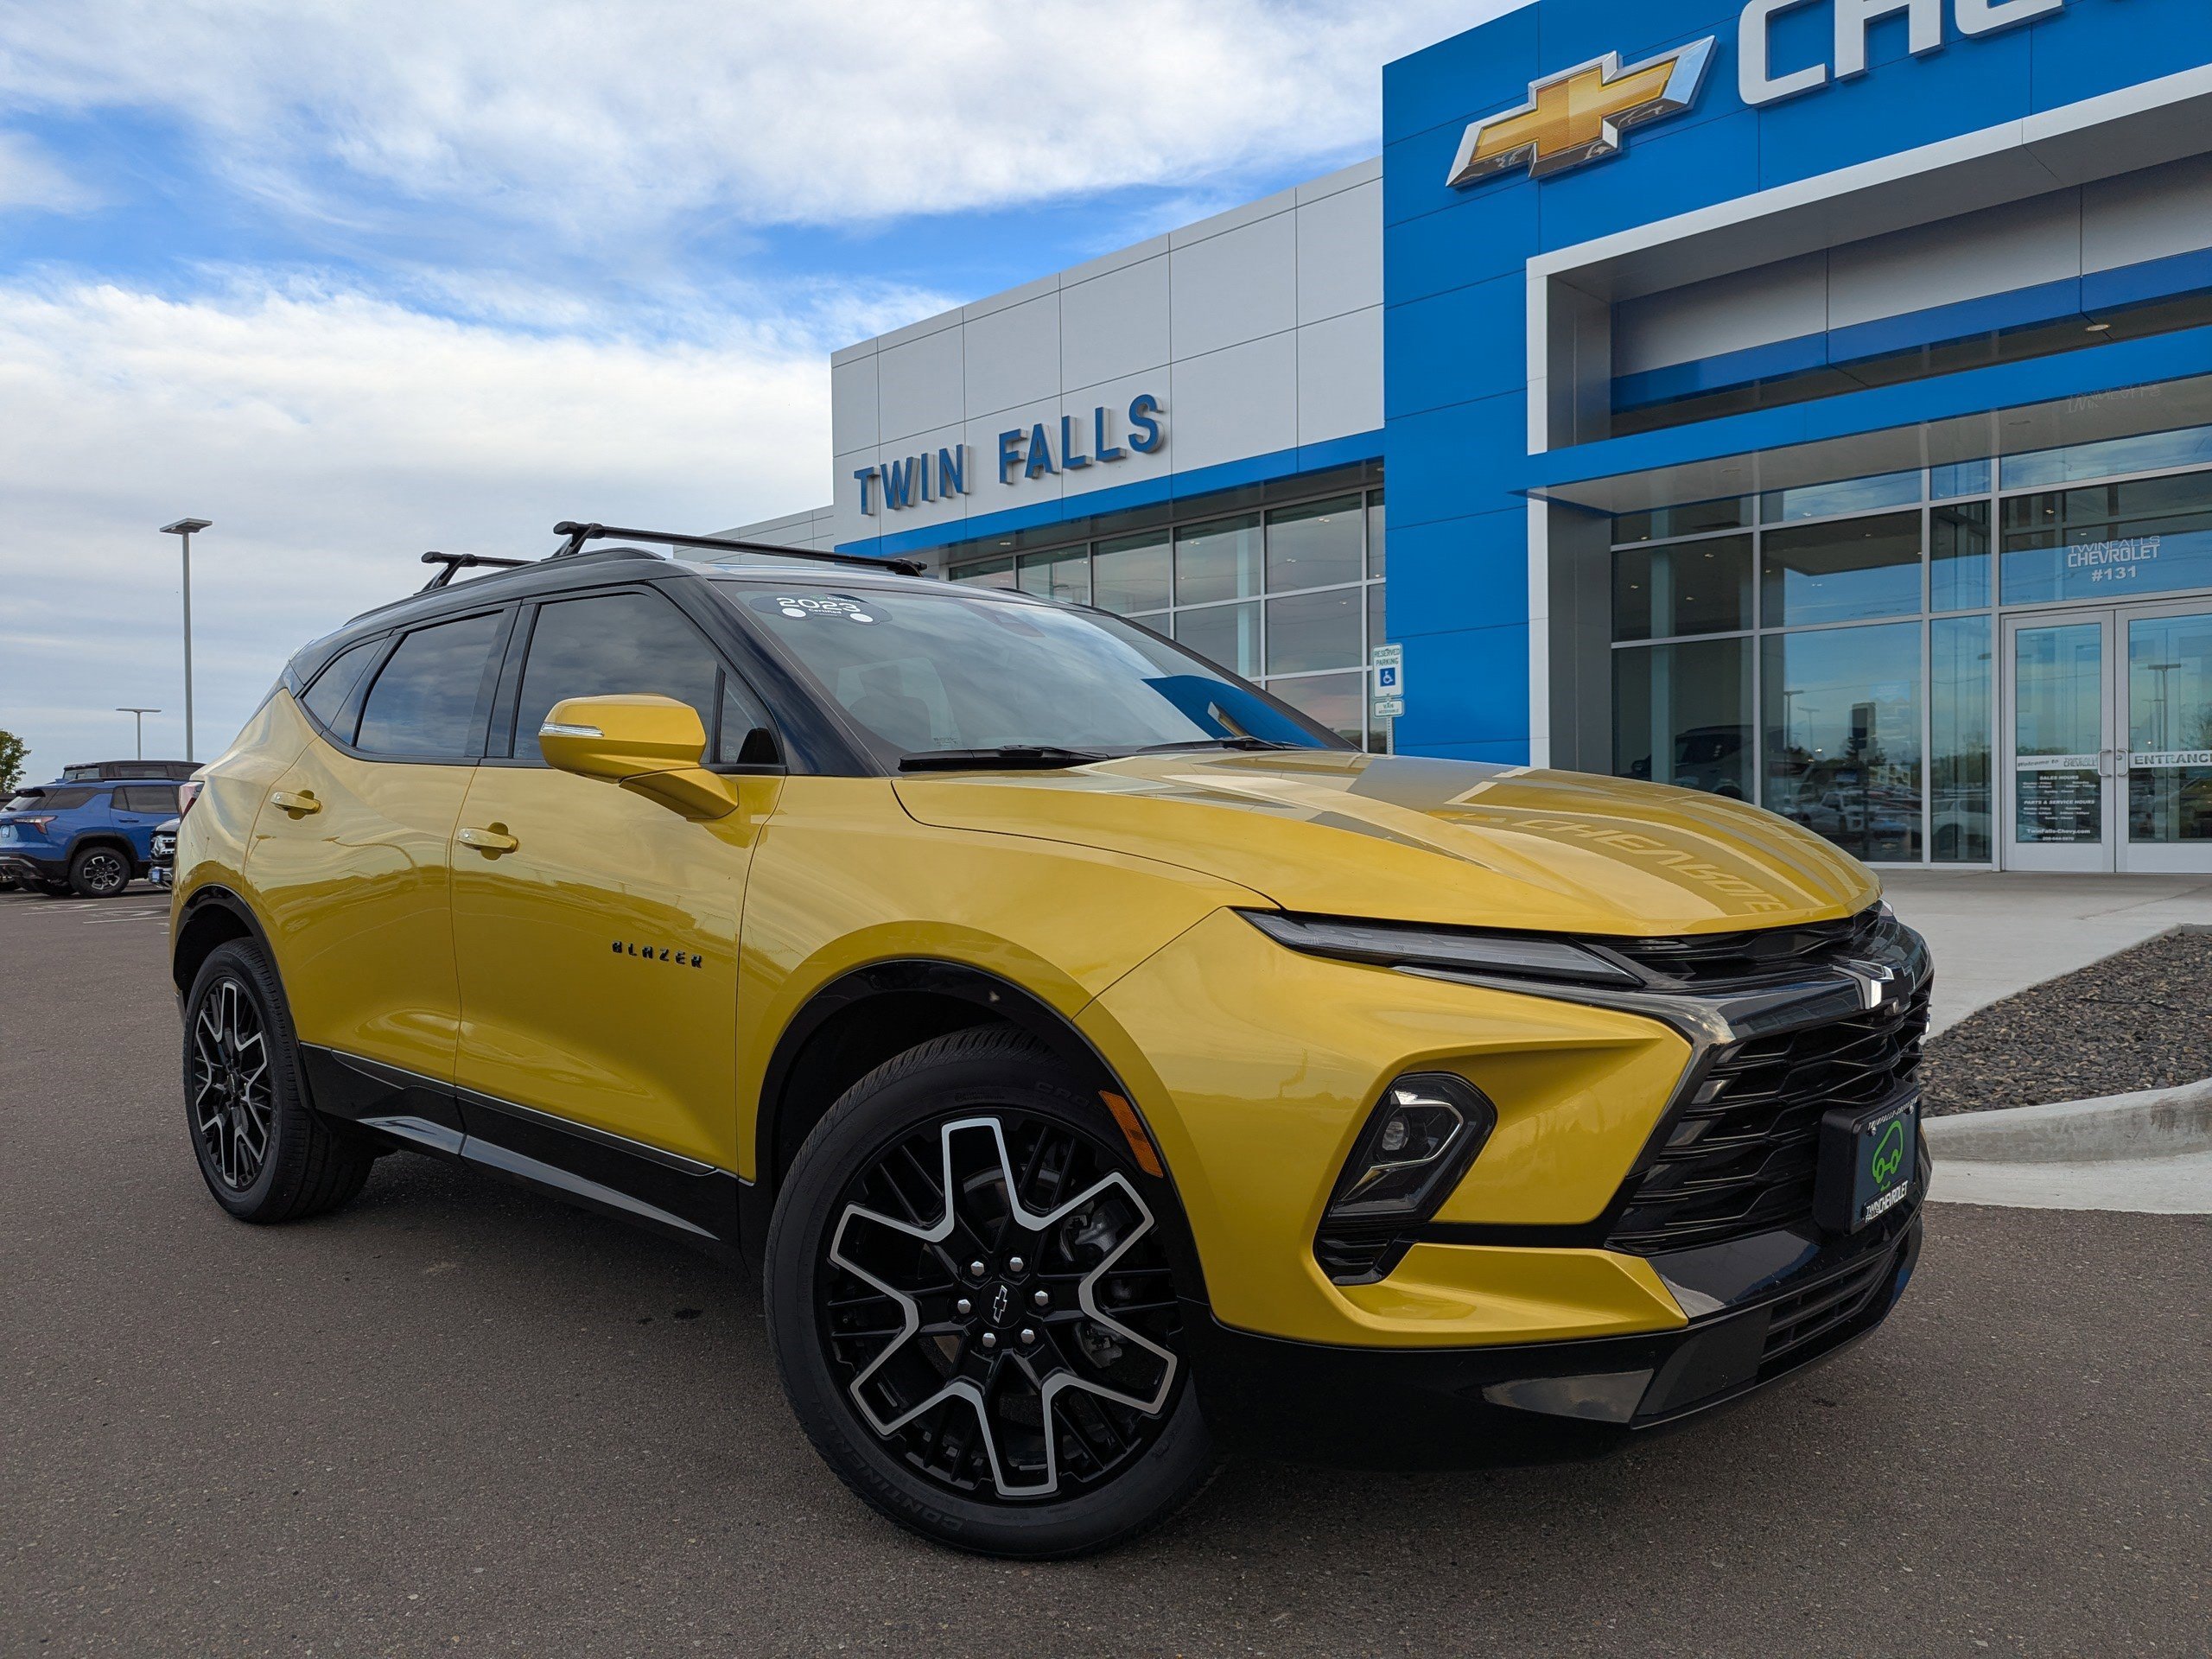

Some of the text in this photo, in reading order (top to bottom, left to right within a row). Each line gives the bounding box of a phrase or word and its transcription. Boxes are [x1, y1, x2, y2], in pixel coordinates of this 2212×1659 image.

[1738, 0, 2065, 107] CH
[854, 393, 1164, 516] TWIN FALLS
[2068, 544, 2160, 568] CHEVROLET
[2091, 565, 2138, 582] #131
[776, 597, 861, 613] 2023
[1373, 648, 1400, 658] RESERVED
[1376, 658, 1399, 666] PARKING
[2134, 753, 2212, 765] ENTRANC
[612, 940, 702, 969] BLAZER
[1878, 1180, 1909, 1215] CHEVROLET
